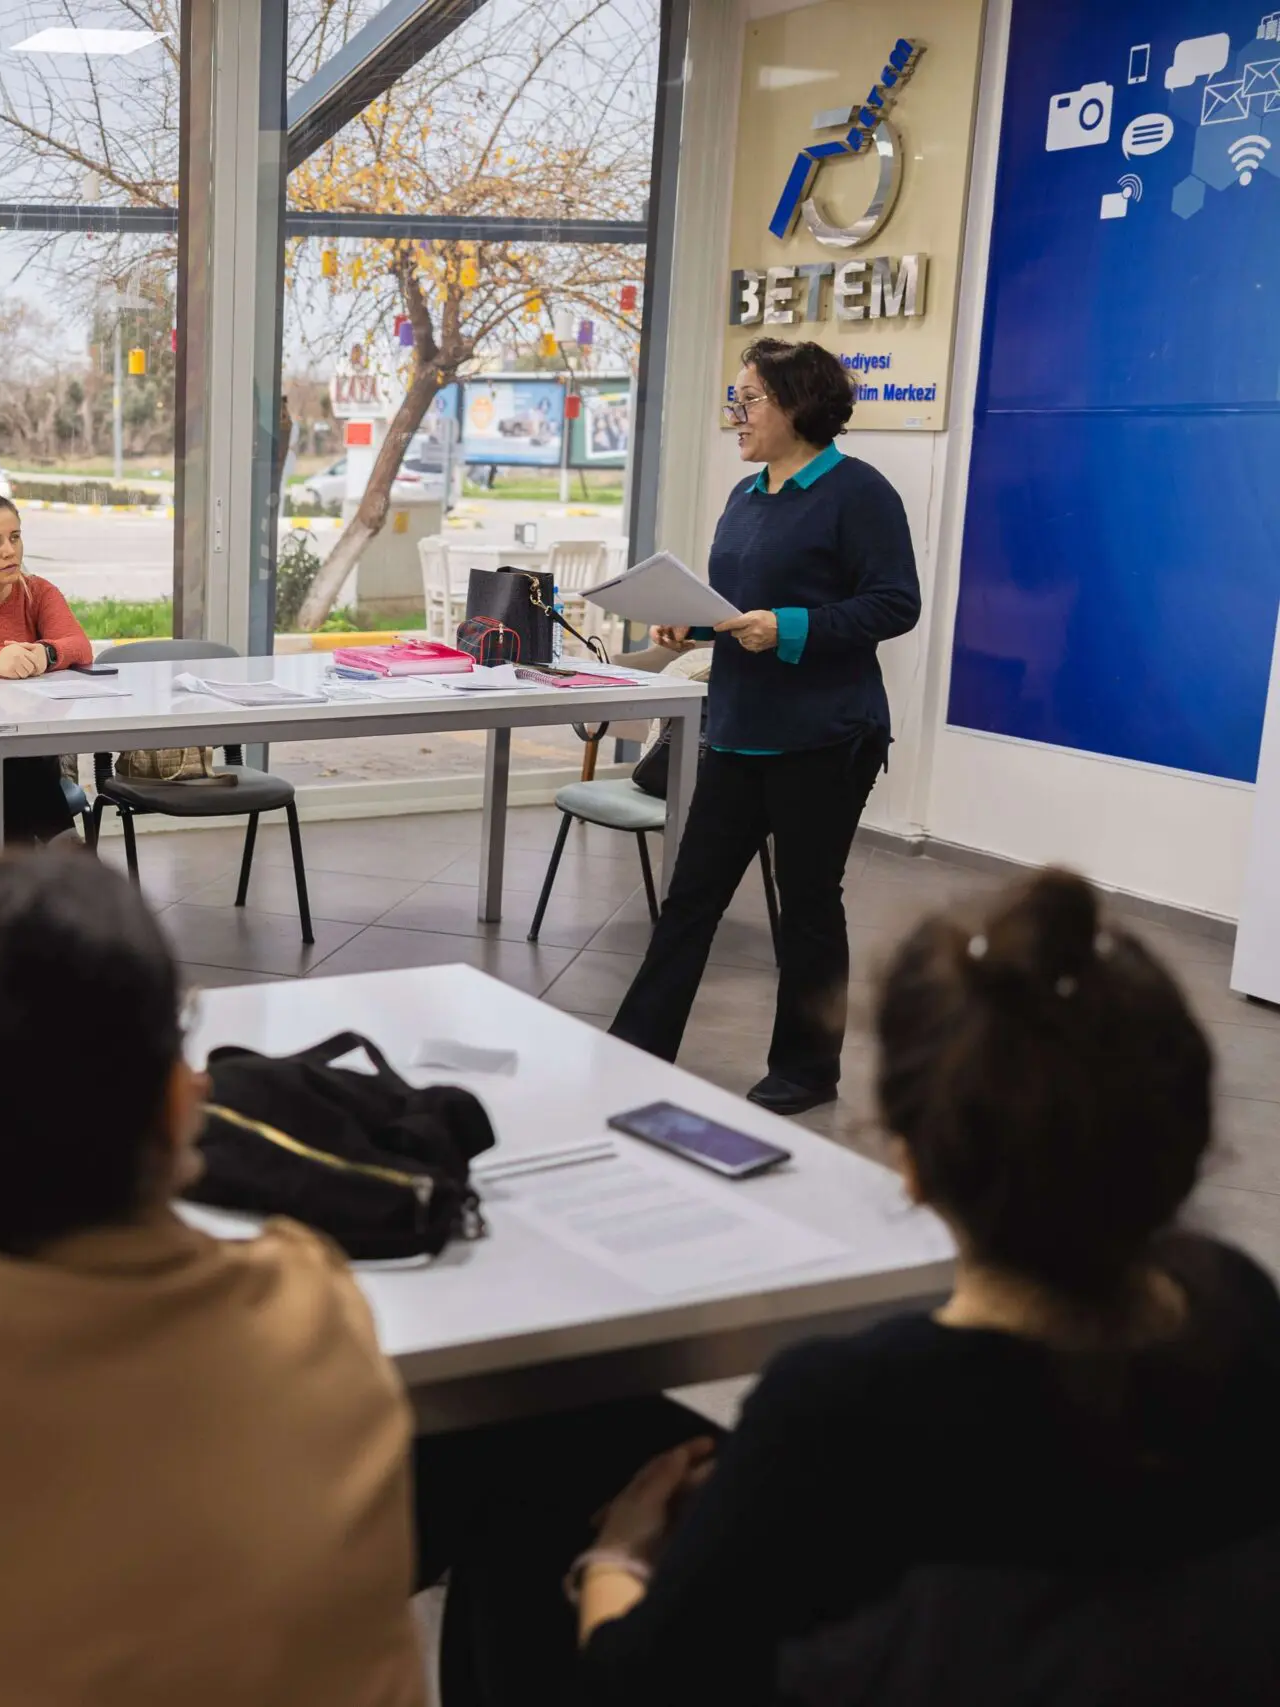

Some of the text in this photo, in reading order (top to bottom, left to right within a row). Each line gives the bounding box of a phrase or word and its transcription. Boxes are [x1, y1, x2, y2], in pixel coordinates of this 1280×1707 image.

[729, 253, 925, 325] BETEM
[840, 352, 893, 374] lediyesi
[883, 383, 937, 401] Merkezi
